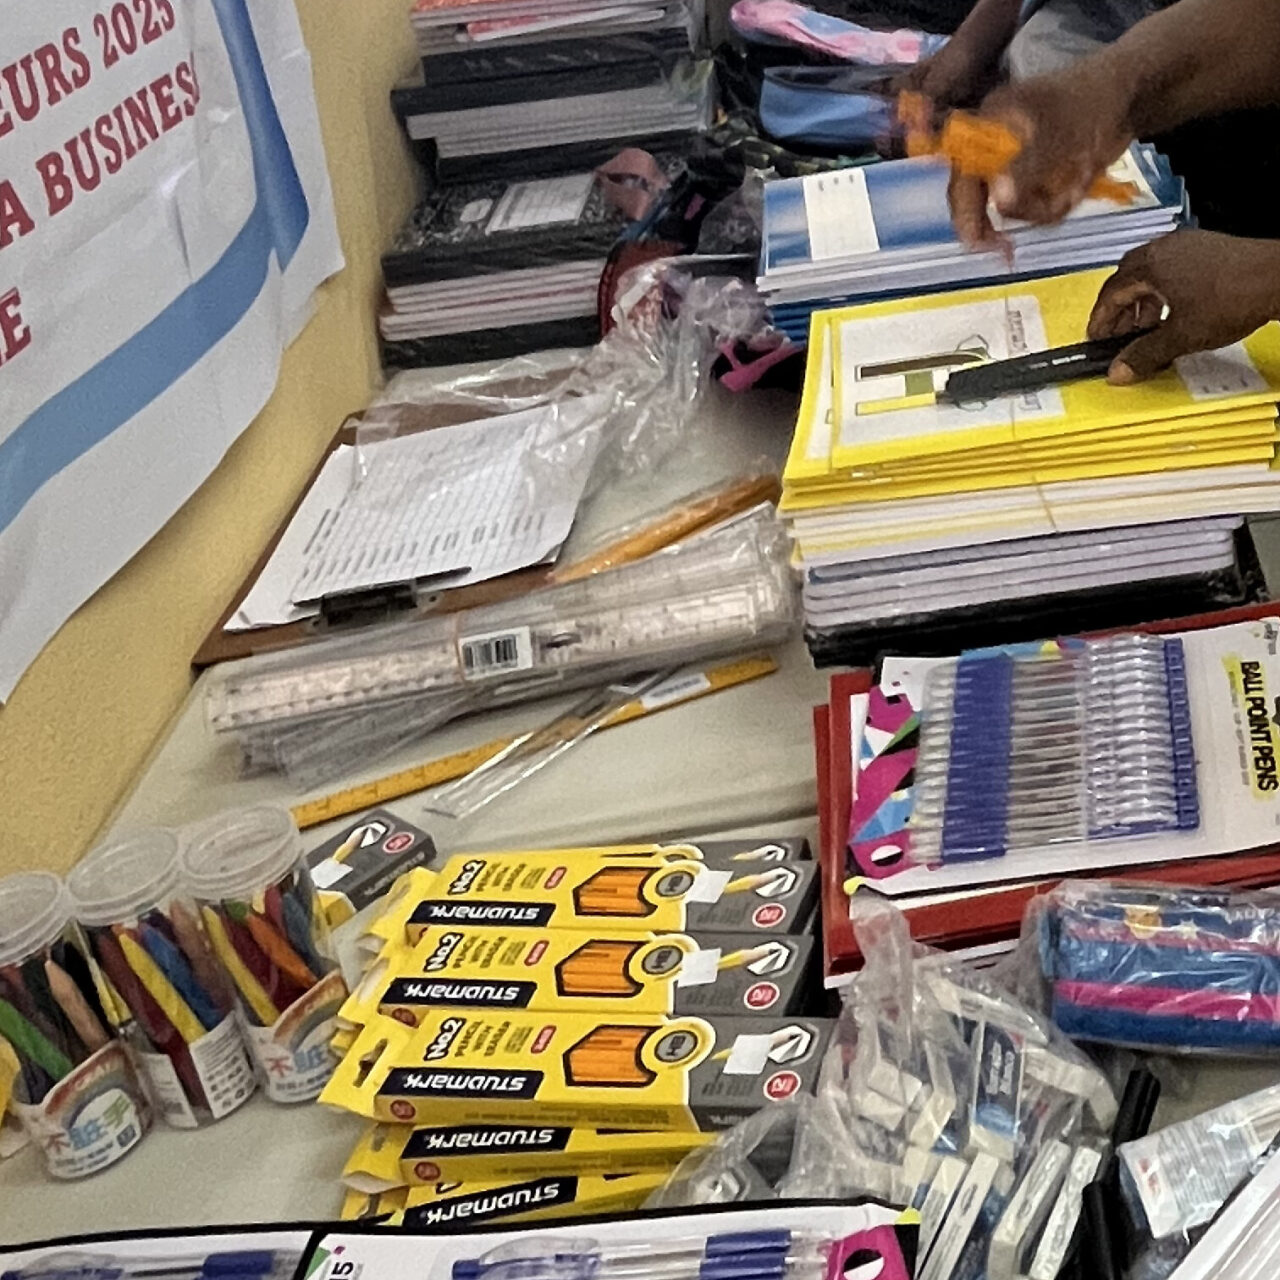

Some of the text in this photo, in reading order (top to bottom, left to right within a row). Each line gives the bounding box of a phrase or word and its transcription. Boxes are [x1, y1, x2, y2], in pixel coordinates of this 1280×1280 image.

[35, 50, 200, 217] BUSINES
[0, 286, 31, 367] E
[1240, 660, 1279, 792] BALL POINT PENS
